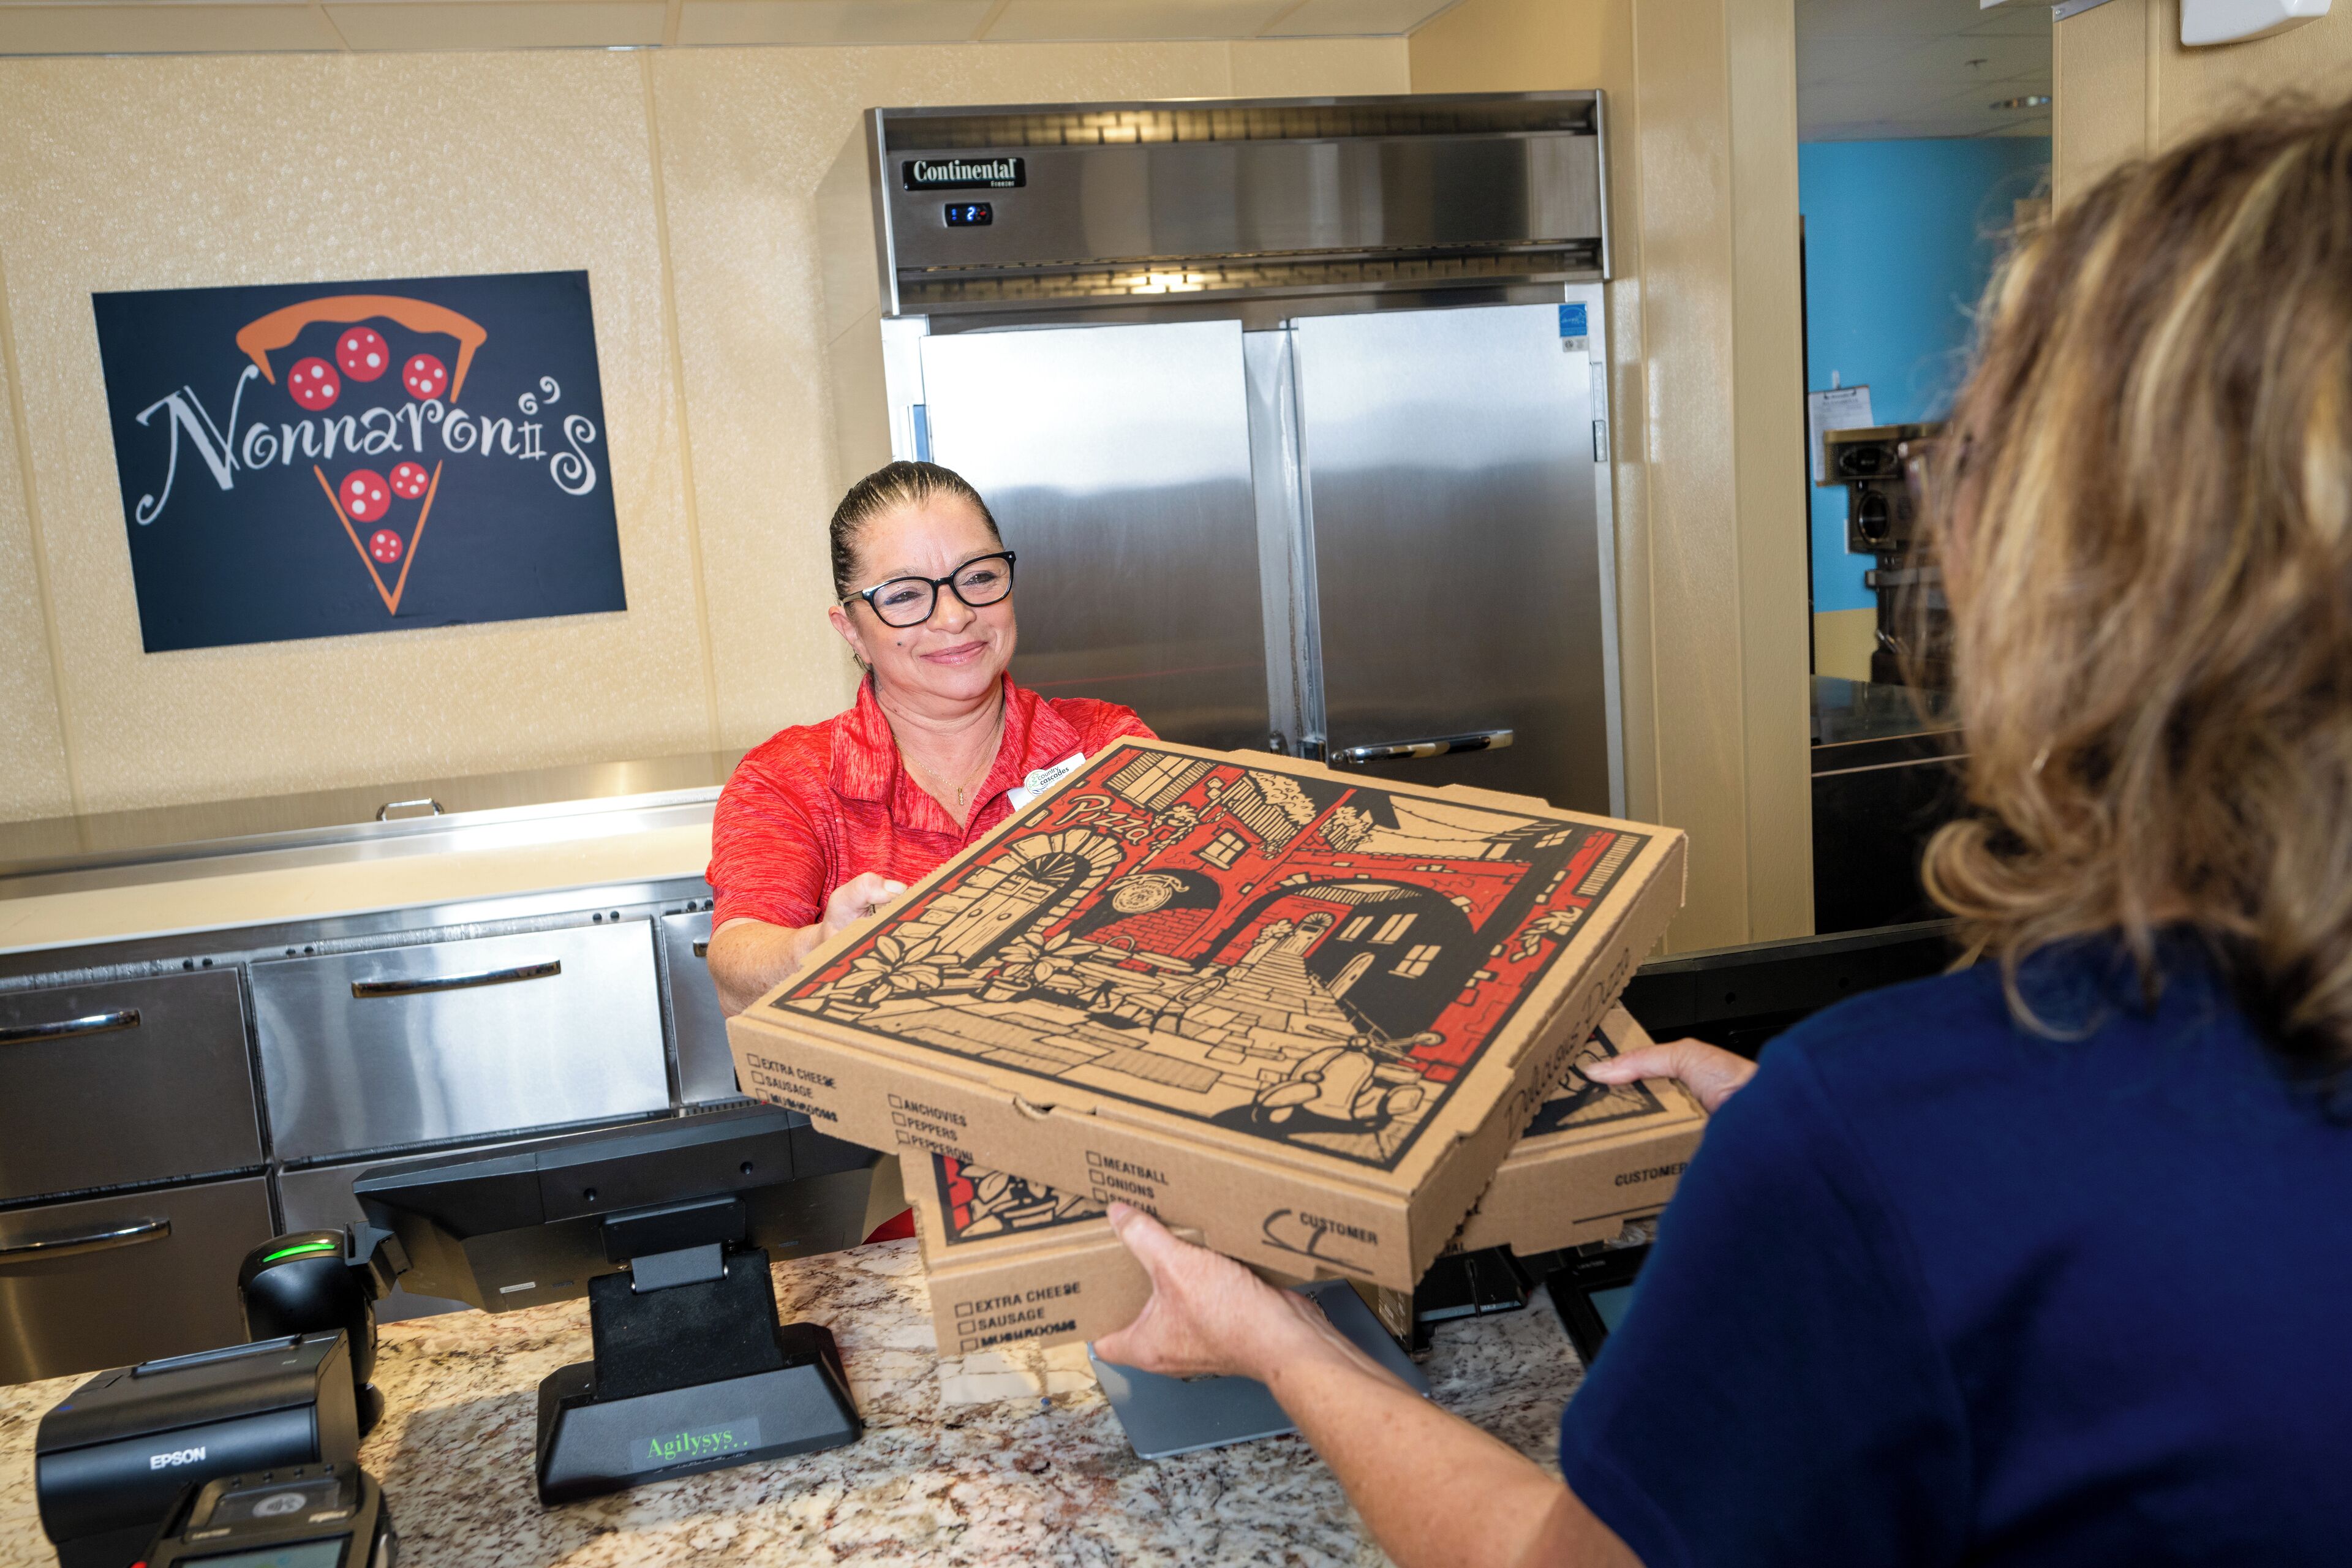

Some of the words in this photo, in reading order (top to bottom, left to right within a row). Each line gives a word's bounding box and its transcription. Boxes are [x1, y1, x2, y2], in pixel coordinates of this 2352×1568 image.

[913, 158, 1016, 182] Continental
[135, 363, 597, 526] Nonnaroni's
[1038, 766, 1060, 781] country
[1040, 767, 1069, 785] cascades
[1054, 794, 1150, 846] Pizza
[761, 1058, 794, 1077] EXTRA
[797, 1068, 837, 1090] CHEESE
[766, 1076, 814, 1099] SAUSAGE
[904, 1099, 967, 1127] ANCHOVIES
[908, 1117, 958, 1142] PEPPERS
[911, 1135, 974, 1164] PEPPERONI
[1104, 1156, 1170, 1186] MEATBALL
[1107, 1175, 1155, 1199] ONIONS
[1300, 1212, 1378, 1246] CUSTOMER
[976, 1294, 1022, 1313] EXTRA
[1027, 1281, 1081, 1303] CHEESE
[978, 1306, 1046, 1331] SAUSAGE
[150, 1446, 206, 1470] EPSON
[647, 1430, 733, 1461] Agilysys
